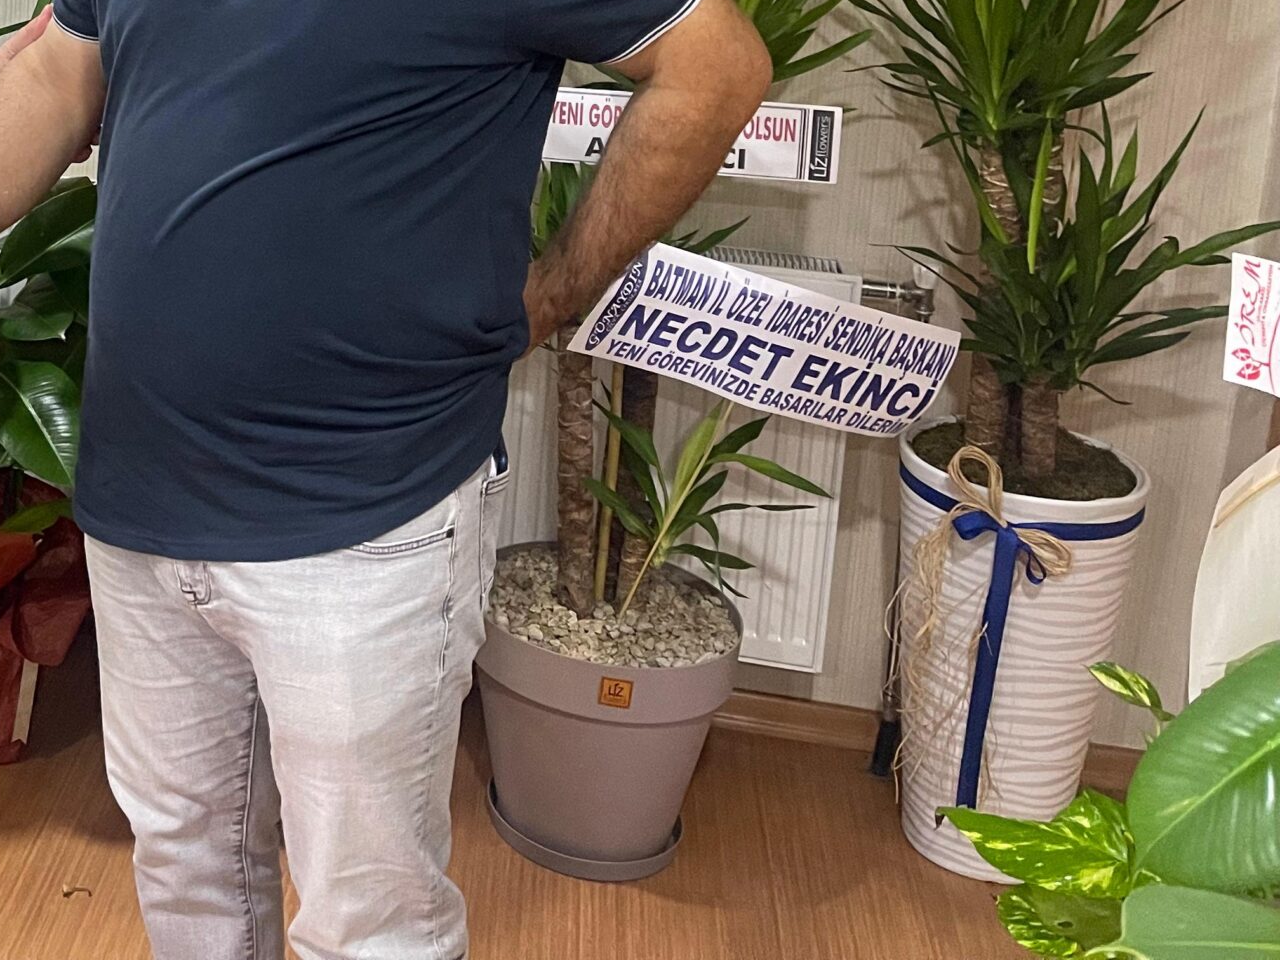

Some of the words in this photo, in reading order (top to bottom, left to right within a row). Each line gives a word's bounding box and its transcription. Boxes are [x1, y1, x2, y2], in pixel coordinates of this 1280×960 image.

[551, 95, 584, 126] YENİ
[619, 304, 795, 381] NECDET
[791, 352, 939, 422] EKİNCİ
[644, 260, 718, 312] BATMAN
[707, 271, 731, 317] İL
[726, 278, 774, 328] ÖZEL
[765, 290, 840, 346] İDARESİ
[823, 317, 896, 365] SENDİKA
[886, 333, 956, 382] BAŞKANI
[606, 338, 651, 363] YENİ
[647, 350, 762, 401] GÖREVİNİZDE
[759, 391, 847, 425] BAŞARILAR
